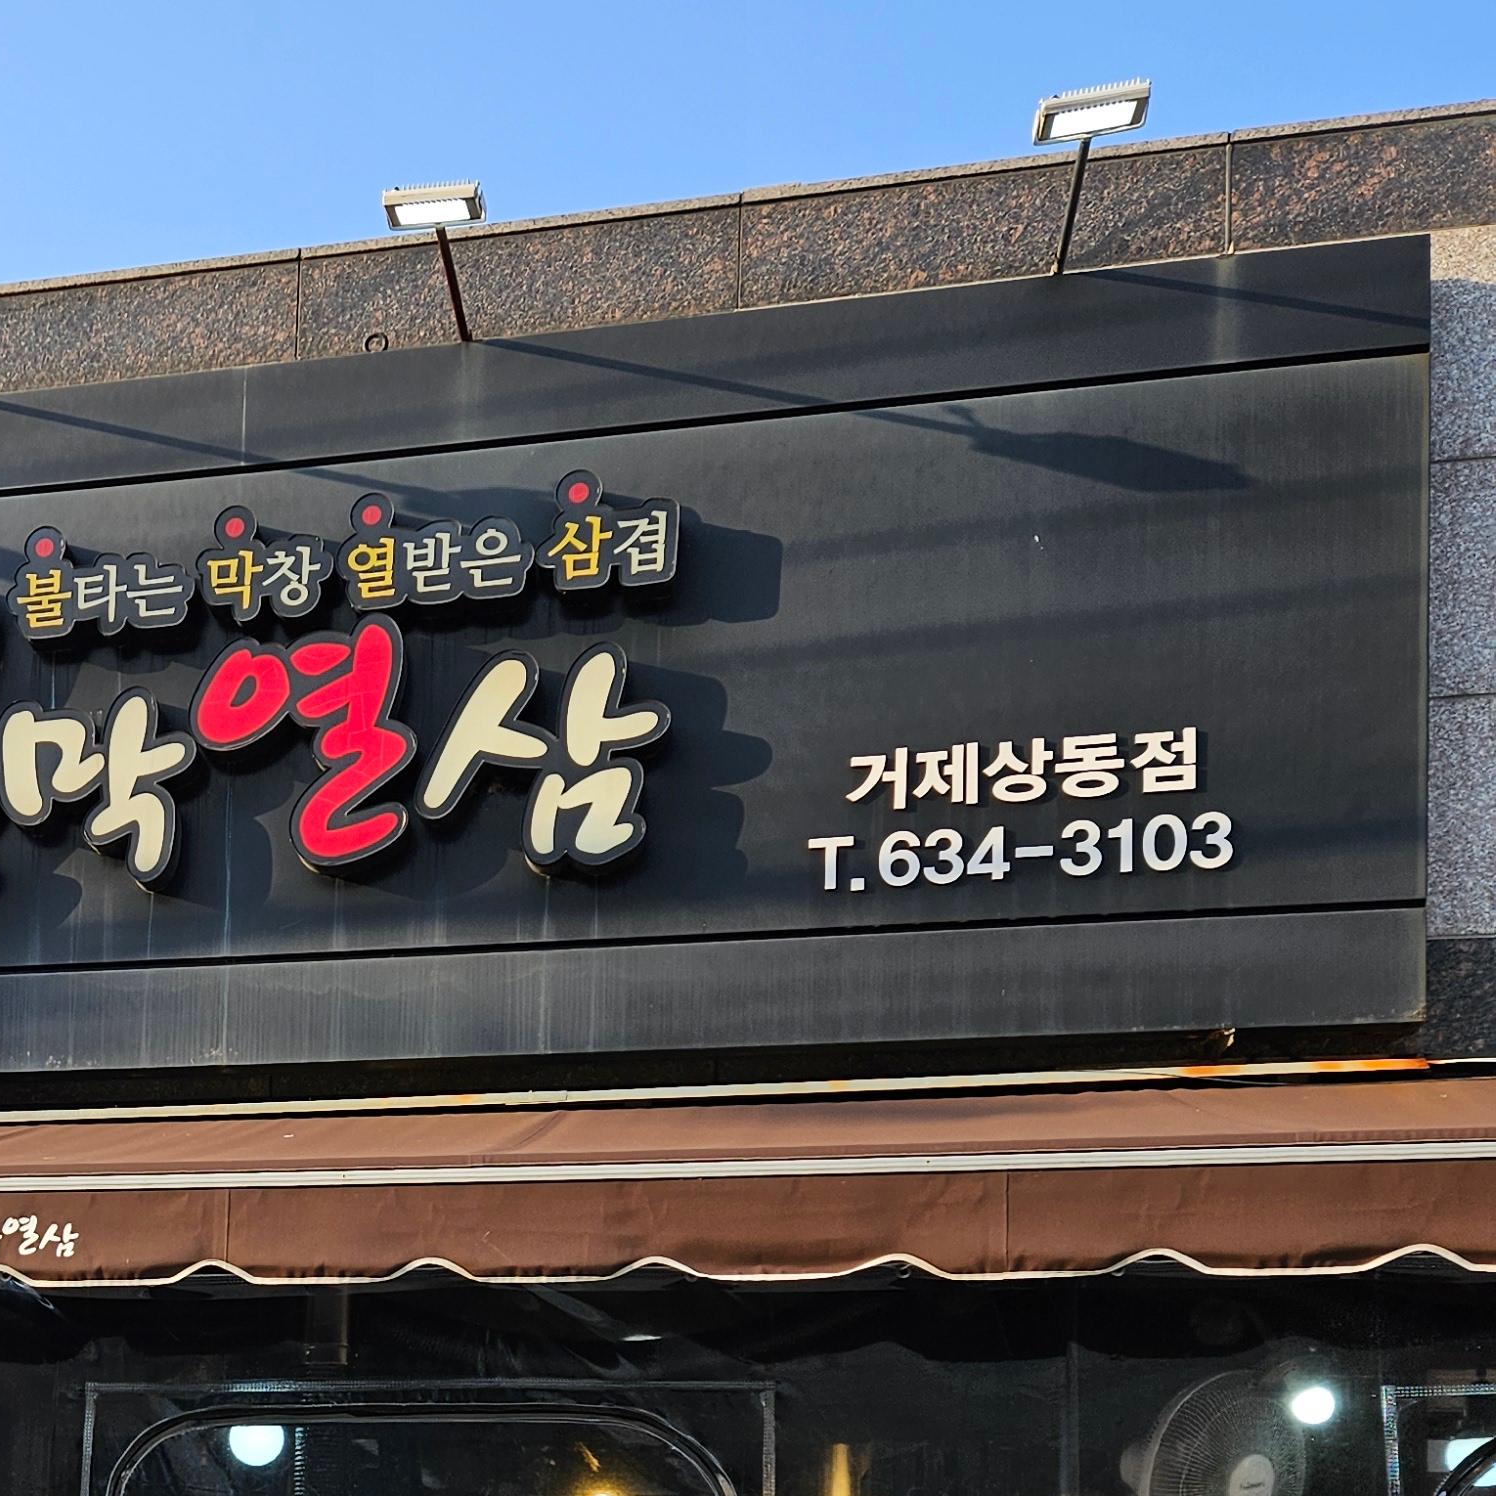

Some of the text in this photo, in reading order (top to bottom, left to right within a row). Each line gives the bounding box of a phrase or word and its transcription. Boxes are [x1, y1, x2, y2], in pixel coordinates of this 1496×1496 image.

[18, 511, 669, 629] 불타는 막창 열받은 삼겹
[846, 727, 1200, 811] 거제상동점
